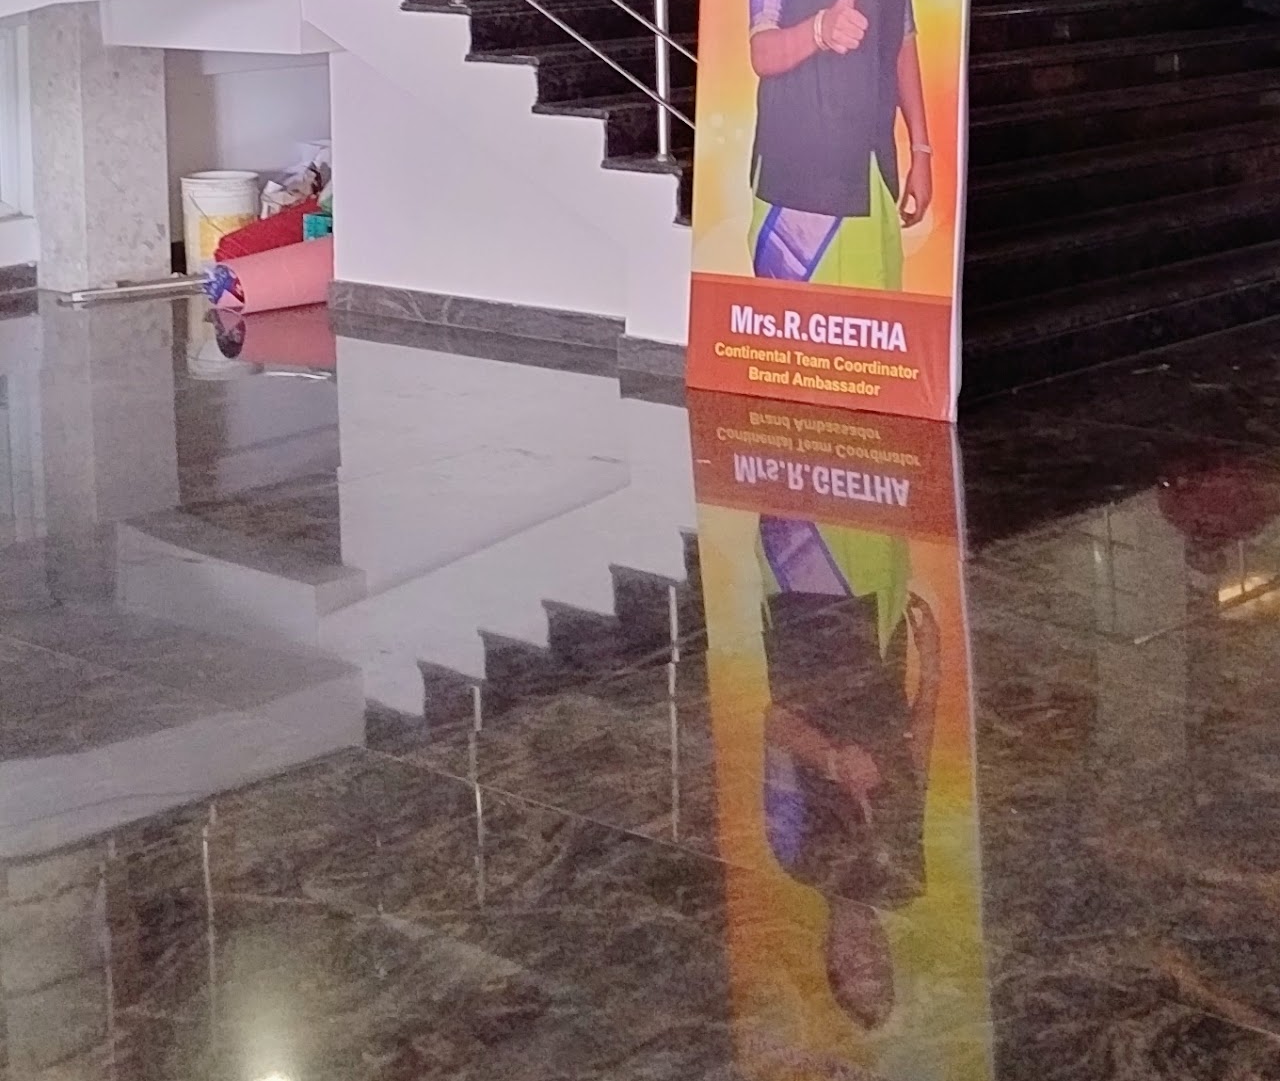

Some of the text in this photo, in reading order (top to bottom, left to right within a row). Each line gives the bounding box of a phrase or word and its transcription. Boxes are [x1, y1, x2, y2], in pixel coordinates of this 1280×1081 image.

[730, 304, 908, 353] Mrs.R.GEETHA
[714, 342, 919, 380] Continental Team Coordinator
[748, 366, 881, 397] Brand Ambassador
